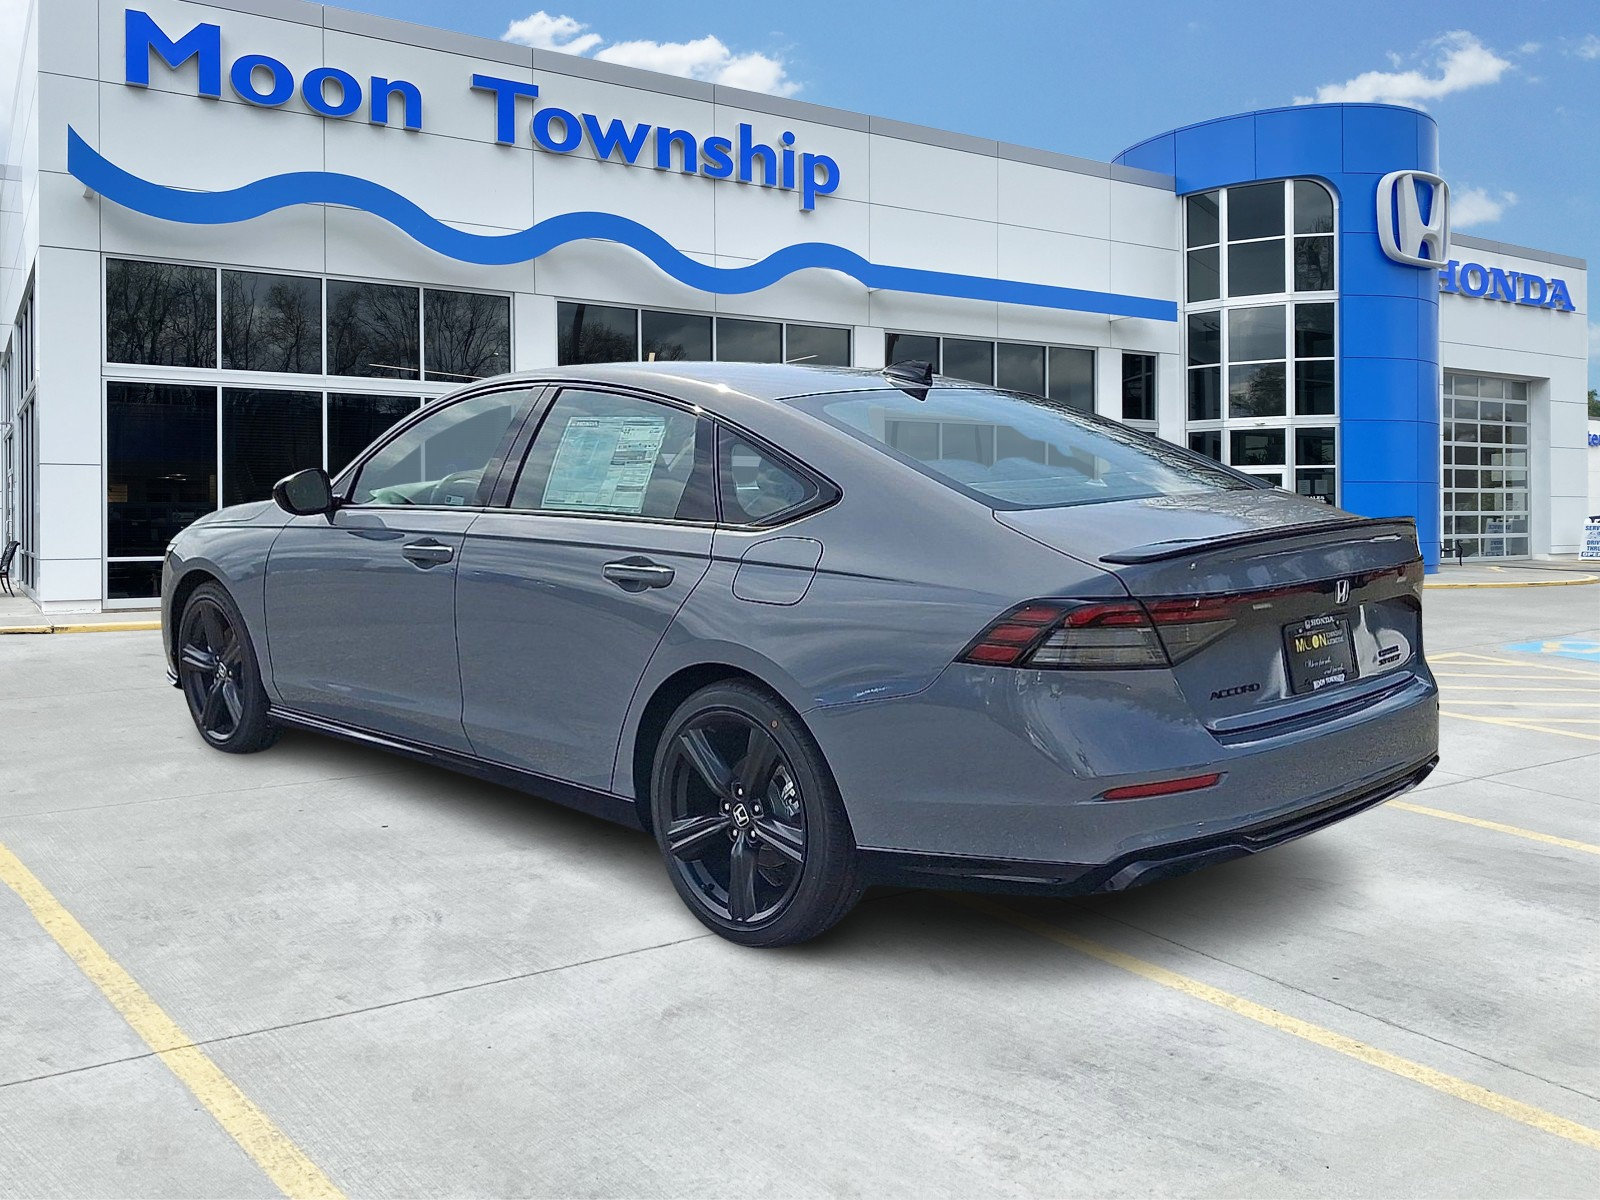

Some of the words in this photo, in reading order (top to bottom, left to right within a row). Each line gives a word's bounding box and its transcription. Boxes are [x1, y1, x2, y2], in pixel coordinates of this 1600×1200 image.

[125, 9, 422, 130] Moon
[471, 73, 841, 212] Township
[1439, 259, 1576, 312] HONDA
[1210, 683, 1261, 701] ACCORD
